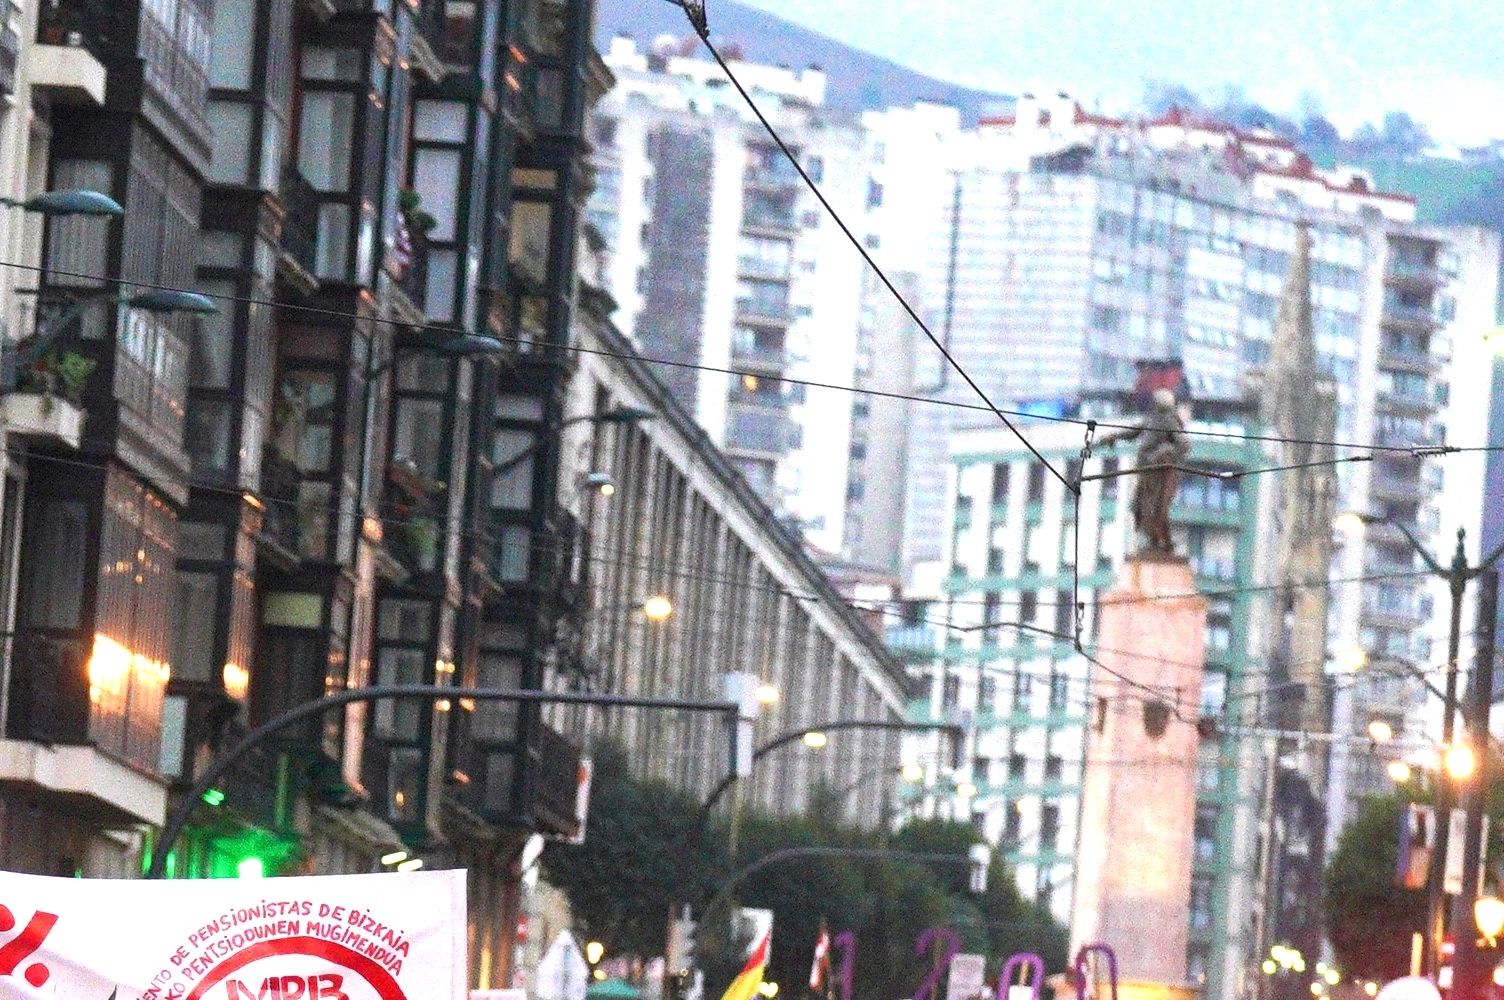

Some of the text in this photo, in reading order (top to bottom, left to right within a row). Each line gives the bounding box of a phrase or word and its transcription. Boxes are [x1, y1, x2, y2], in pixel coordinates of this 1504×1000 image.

[170, 945, 189, 966] DE
[188, 899, 313, 949] PENSIONISTAS
[319, 903, 343, 921] DE
[347, 908, 410, 958] BIZKAIA
[181, 920, 300, 981] PENTSIODUNEN
[306, 920, 403, 977] MUGIMENDUA
